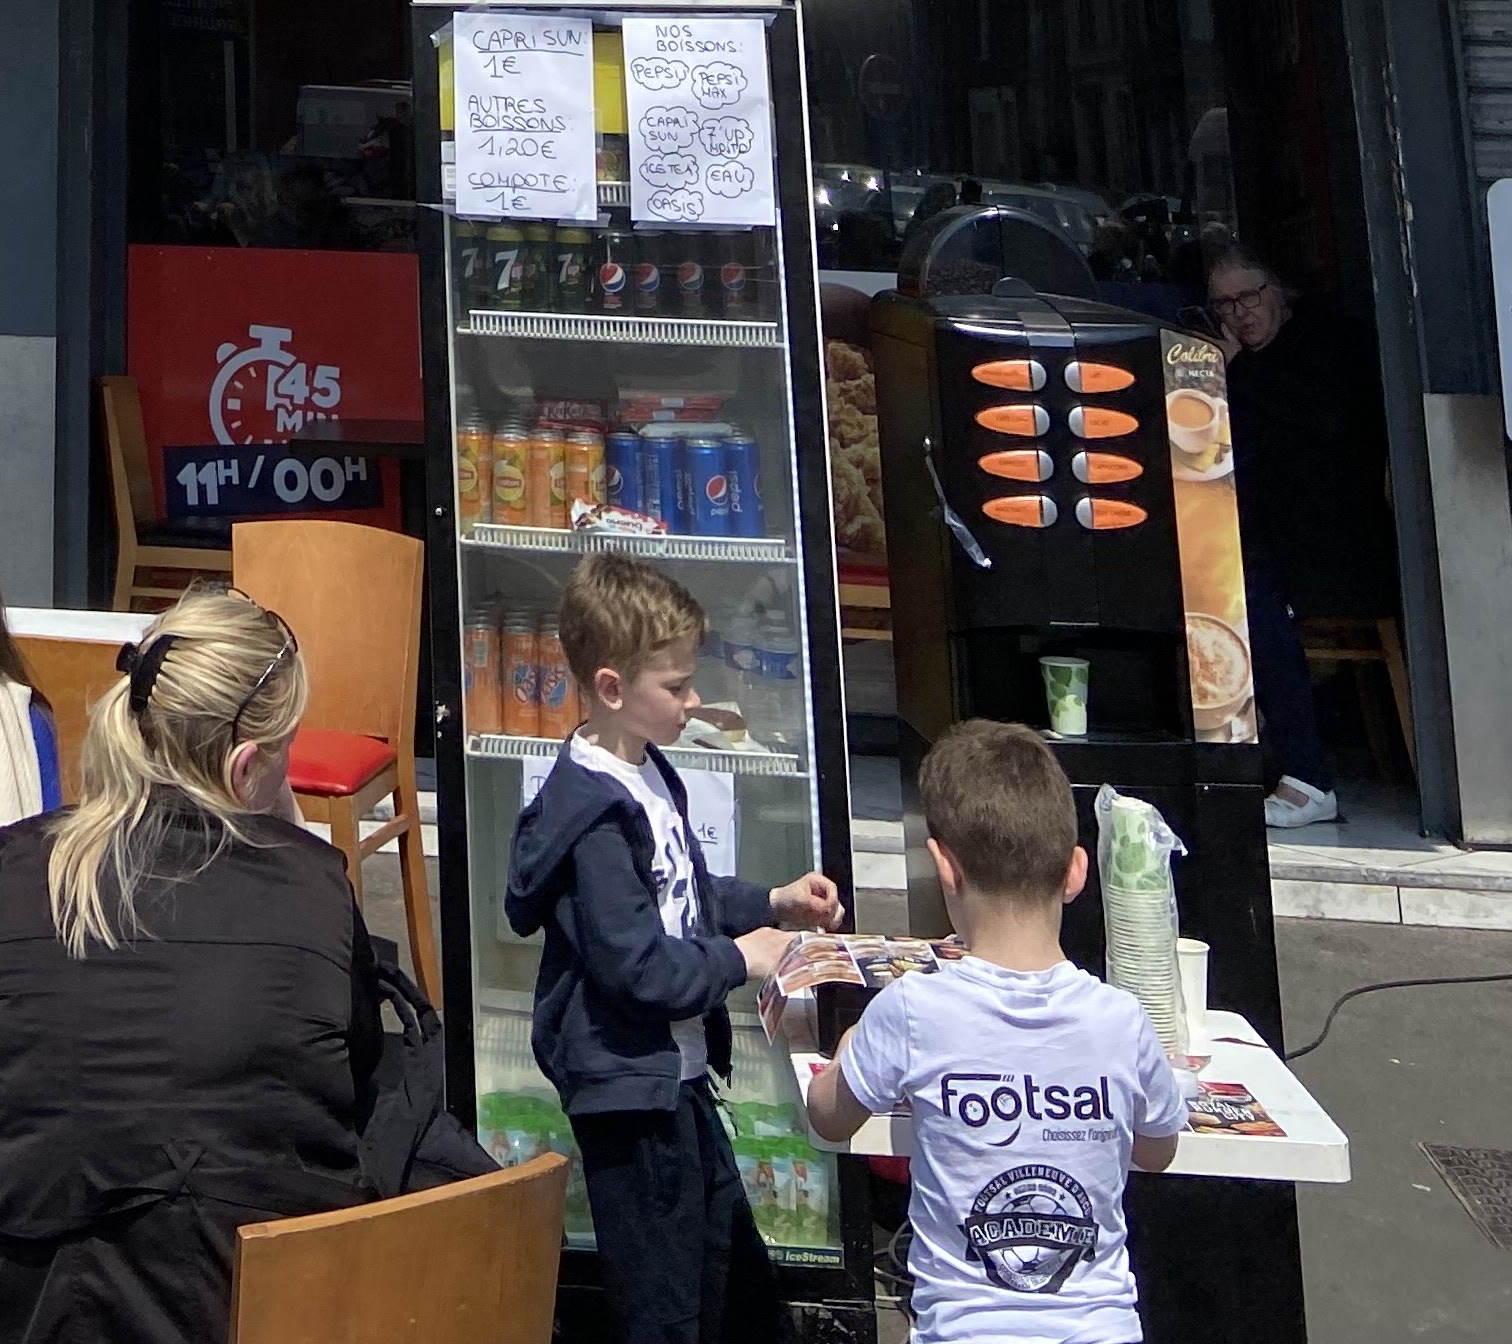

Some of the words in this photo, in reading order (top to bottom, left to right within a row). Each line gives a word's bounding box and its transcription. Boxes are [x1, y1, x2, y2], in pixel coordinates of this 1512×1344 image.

[472, 28, 537, 51] CAPRI
[655, 24, 693, 38] NOS
[483, 54, 522, 79] 1€
[633, 64, 679, 79] PEPSI
[698, 72, 740, 86] PEPSI
[467, 94, 547, 115] AUTRES
[648, 130, 678, 142] SUN
[477, 135, 557, 160] 1,20€
[710, 169, 745, 183] EAU
[485, 191, 532, 211] 1€
[652, 198, 697, 216] OASIS
[277, 362, 342, 409] 45
[974, 1177, 1008, 1213] FOOTSAL
[1009, 1166, 1073, 1188] VILLENEUVE
[786, 1250, 841, 1265] IceStream
